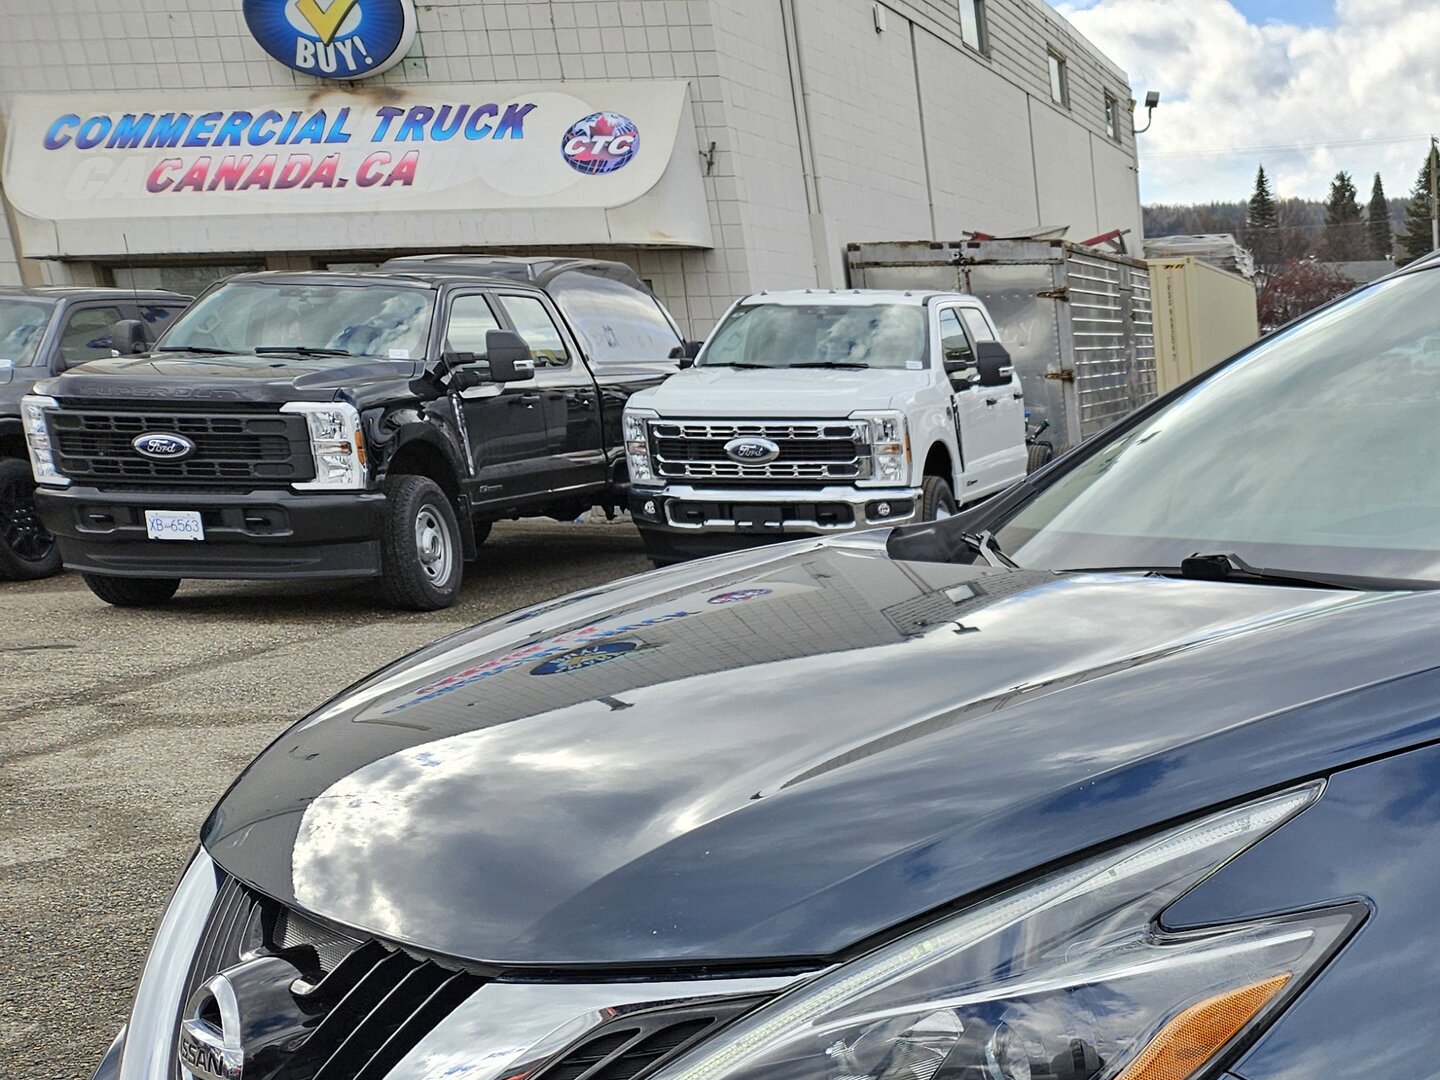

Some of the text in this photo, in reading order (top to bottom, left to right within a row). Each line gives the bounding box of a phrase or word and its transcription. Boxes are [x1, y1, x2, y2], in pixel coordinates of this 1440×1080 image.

[295, 35, 373, 73] BUY!
[43, 103, 538, 150] COMMERCIAL TRUCK
[564, 135, 636, 158] CTC
[146, 150, 420, 193] CANADA.CA
[80, 385, 169, 397] SUPER
[146, 438, 177, 453] Ford
[738, 444, 764, 457] Ford
[180, 1038, 224, 1078] SSAN
